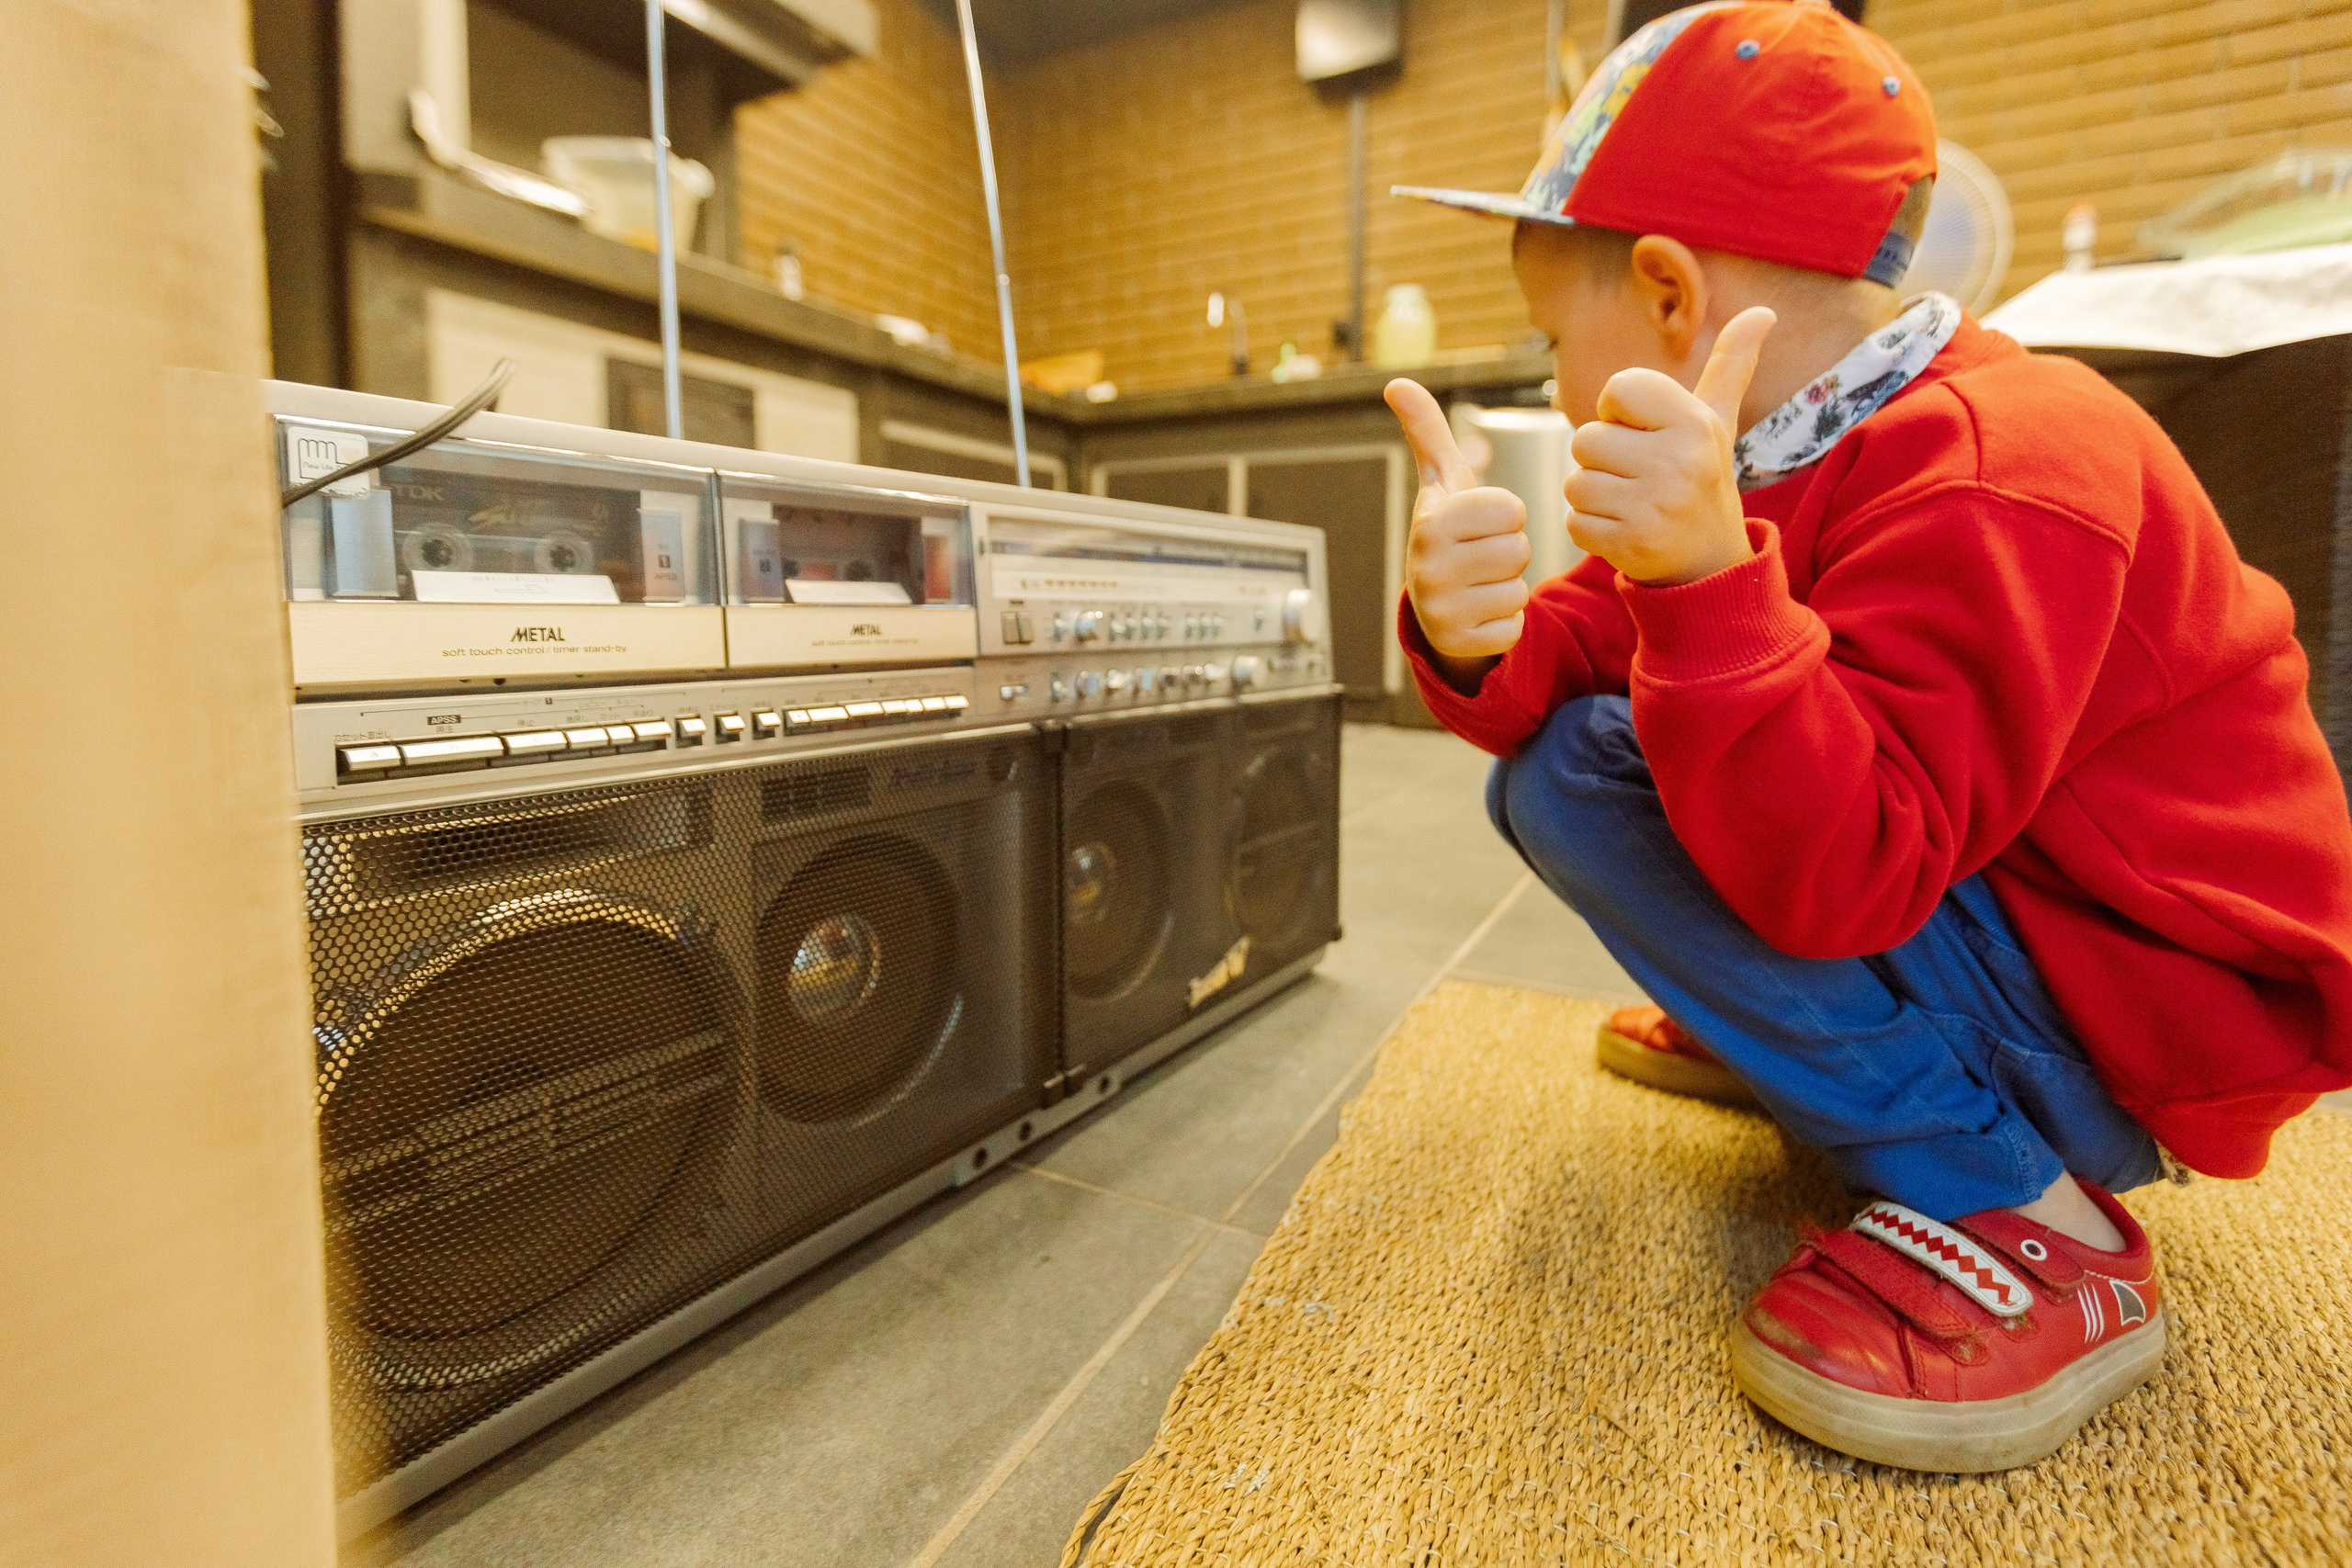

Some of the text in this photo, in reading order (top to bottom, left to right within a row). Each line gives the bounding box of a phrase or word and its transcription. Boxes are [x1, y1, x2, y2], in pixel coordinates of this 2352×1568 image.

[511, 626, 565, 642] METAL
[850, 625, 882, 636] METAL
[441, 648, 466, 657] soft
[469, 647, 502, 656] touch
[553, 646, 580, 654] timer
[582, 645, 627, 654] stand-by
[430, 716, 458, 725] APSS
